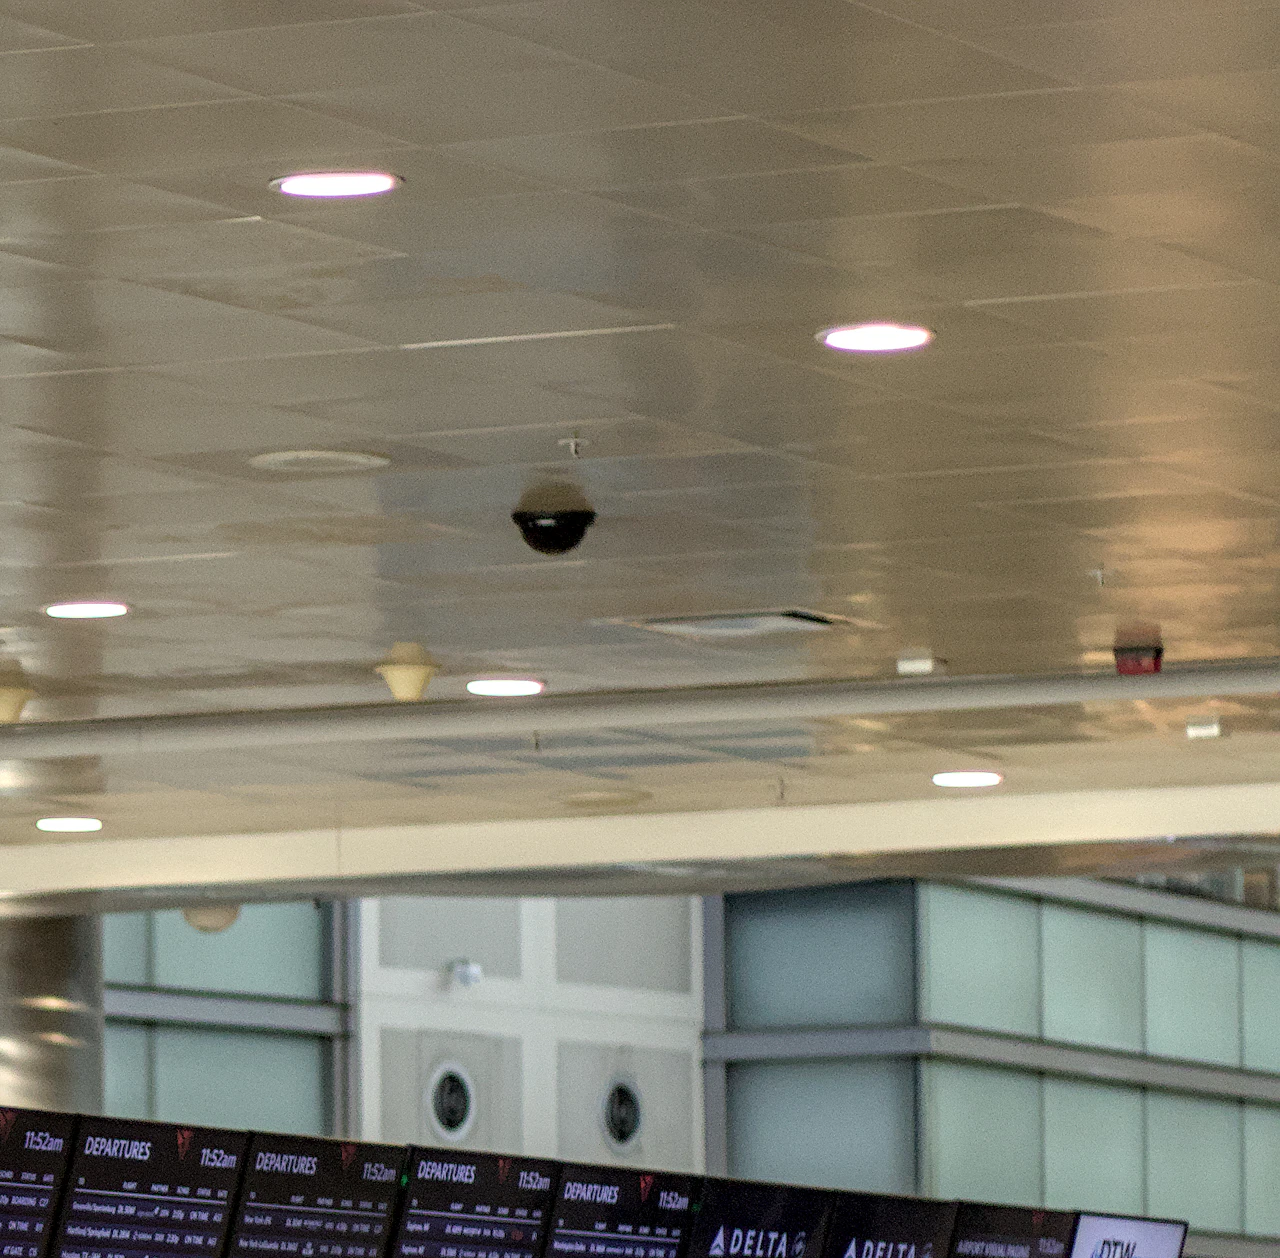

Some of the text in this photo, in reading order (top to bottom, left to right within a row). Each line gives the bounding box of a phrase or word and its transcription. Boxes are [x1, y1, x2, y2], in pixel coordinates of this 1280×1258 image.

[26, 1131, 63, 1151] 11:52am
[85, 1136, 236, 1168] DEPARTURES 11:52am
[256, 1152, 395, 1182] DEPARTURES 11:52am
[418, 1160, 549, 1190] DEPARTURES 11:52am
[565, 1181, 688, 1210] DEPARTURES 11:52am
[730, 1228, 787, 1258] DELTA
